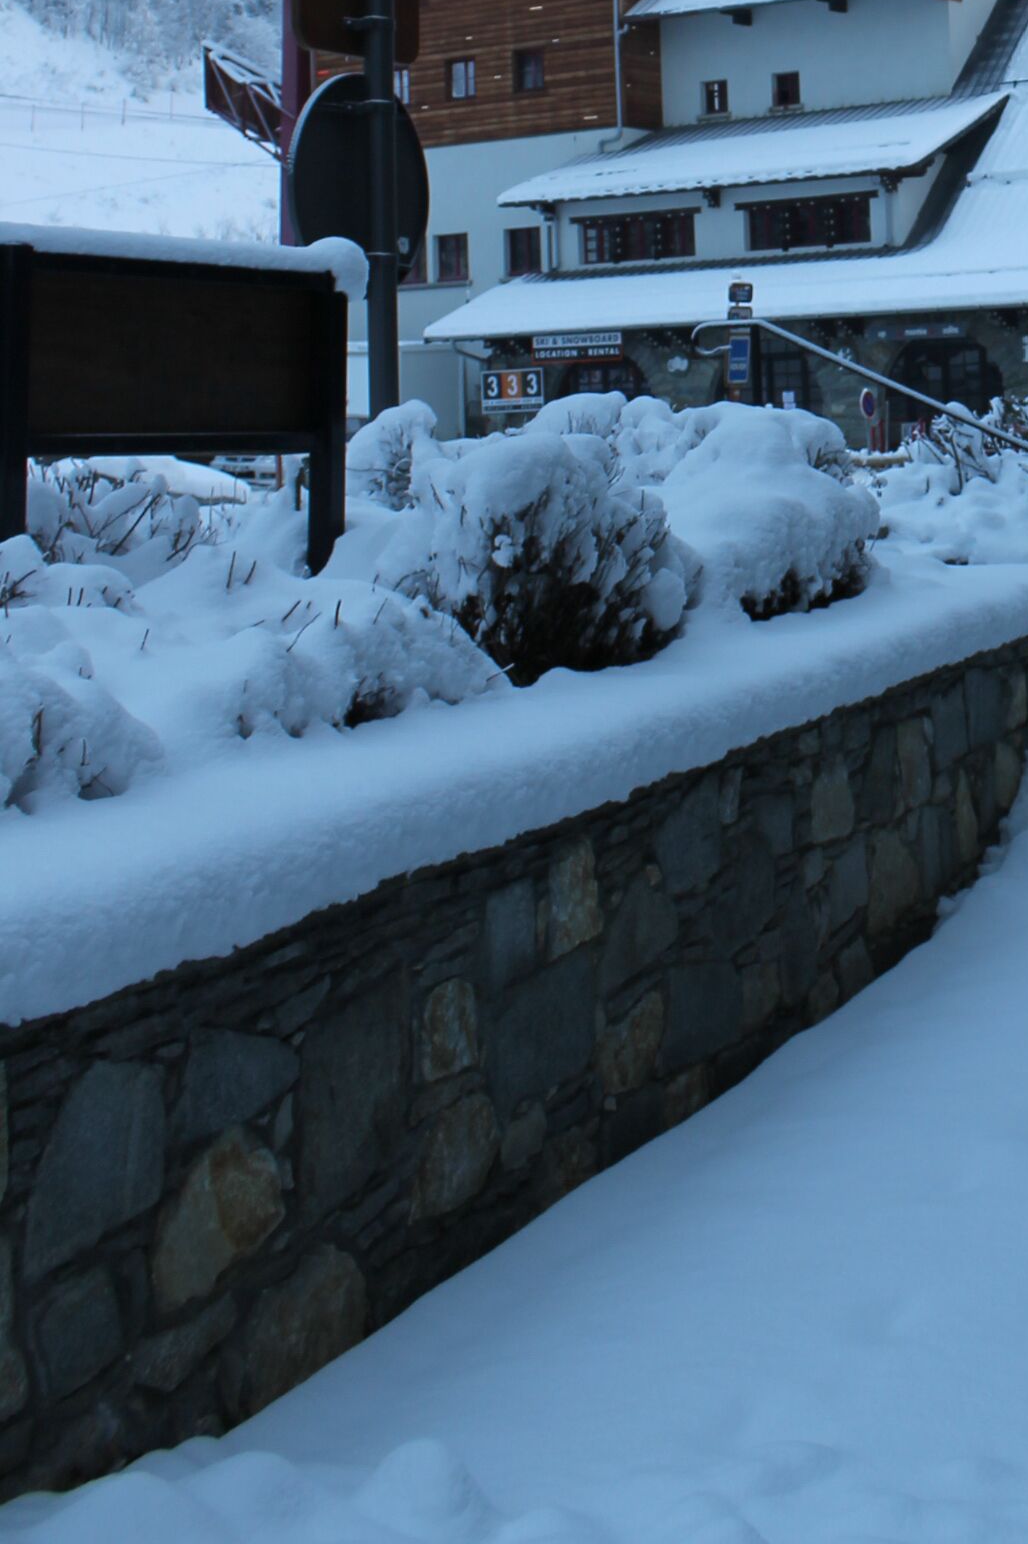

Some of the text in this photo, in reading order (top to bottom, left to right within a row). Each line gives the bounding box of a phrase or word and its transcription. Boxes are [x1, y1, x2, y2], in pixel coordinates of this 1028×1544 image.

[535, 338, 550, 346] SKI
[561, 333, 619, 345] SNOWBOARD
[535, 349, 578, 359] LOCATION
[588, 347, 620, 357] RENTAL
